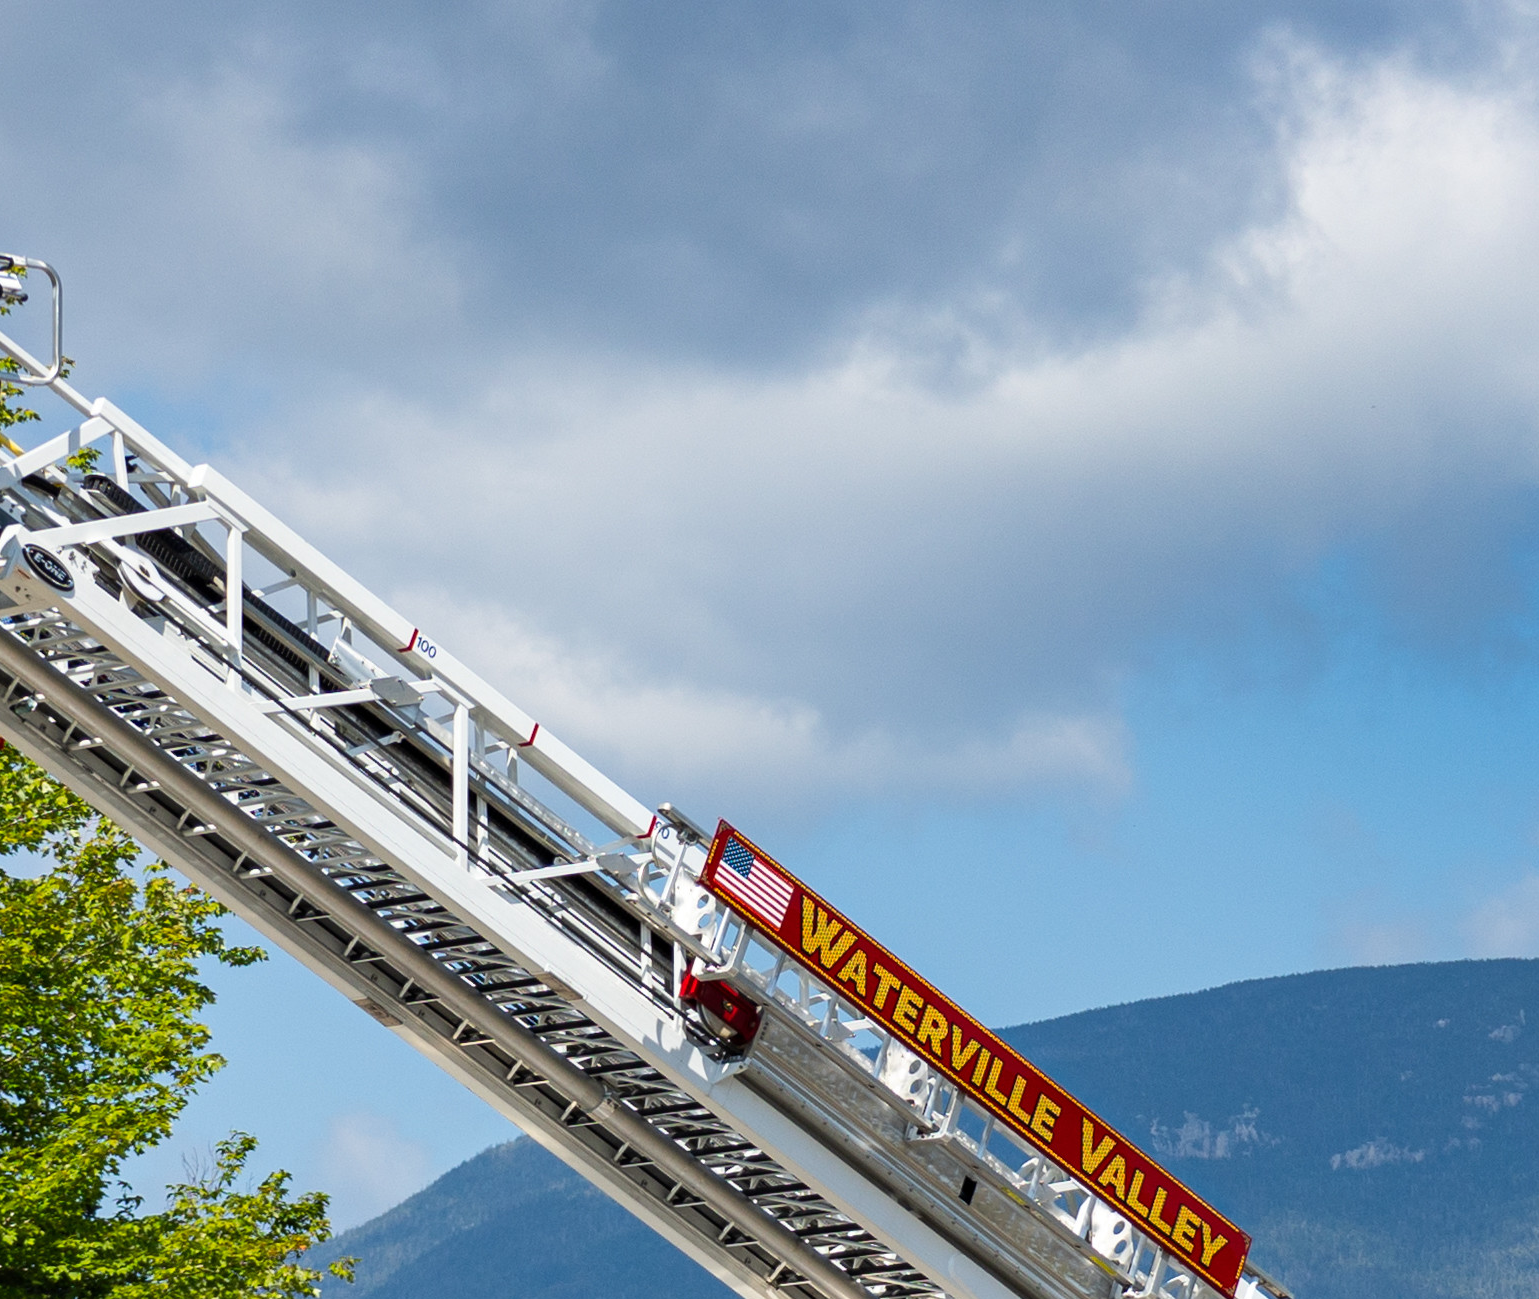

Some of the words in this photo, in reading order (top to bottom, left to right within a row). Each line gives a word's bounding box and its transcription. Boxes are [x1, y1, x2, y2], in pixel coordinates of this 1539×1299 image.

[33, 551, 67, 581] E-ONE
[417, 636, 437, 659] 100
[801, 893, 1062, 1144] WATERVILLE
[1081, 1115, 1229, 1268] VALLEY
